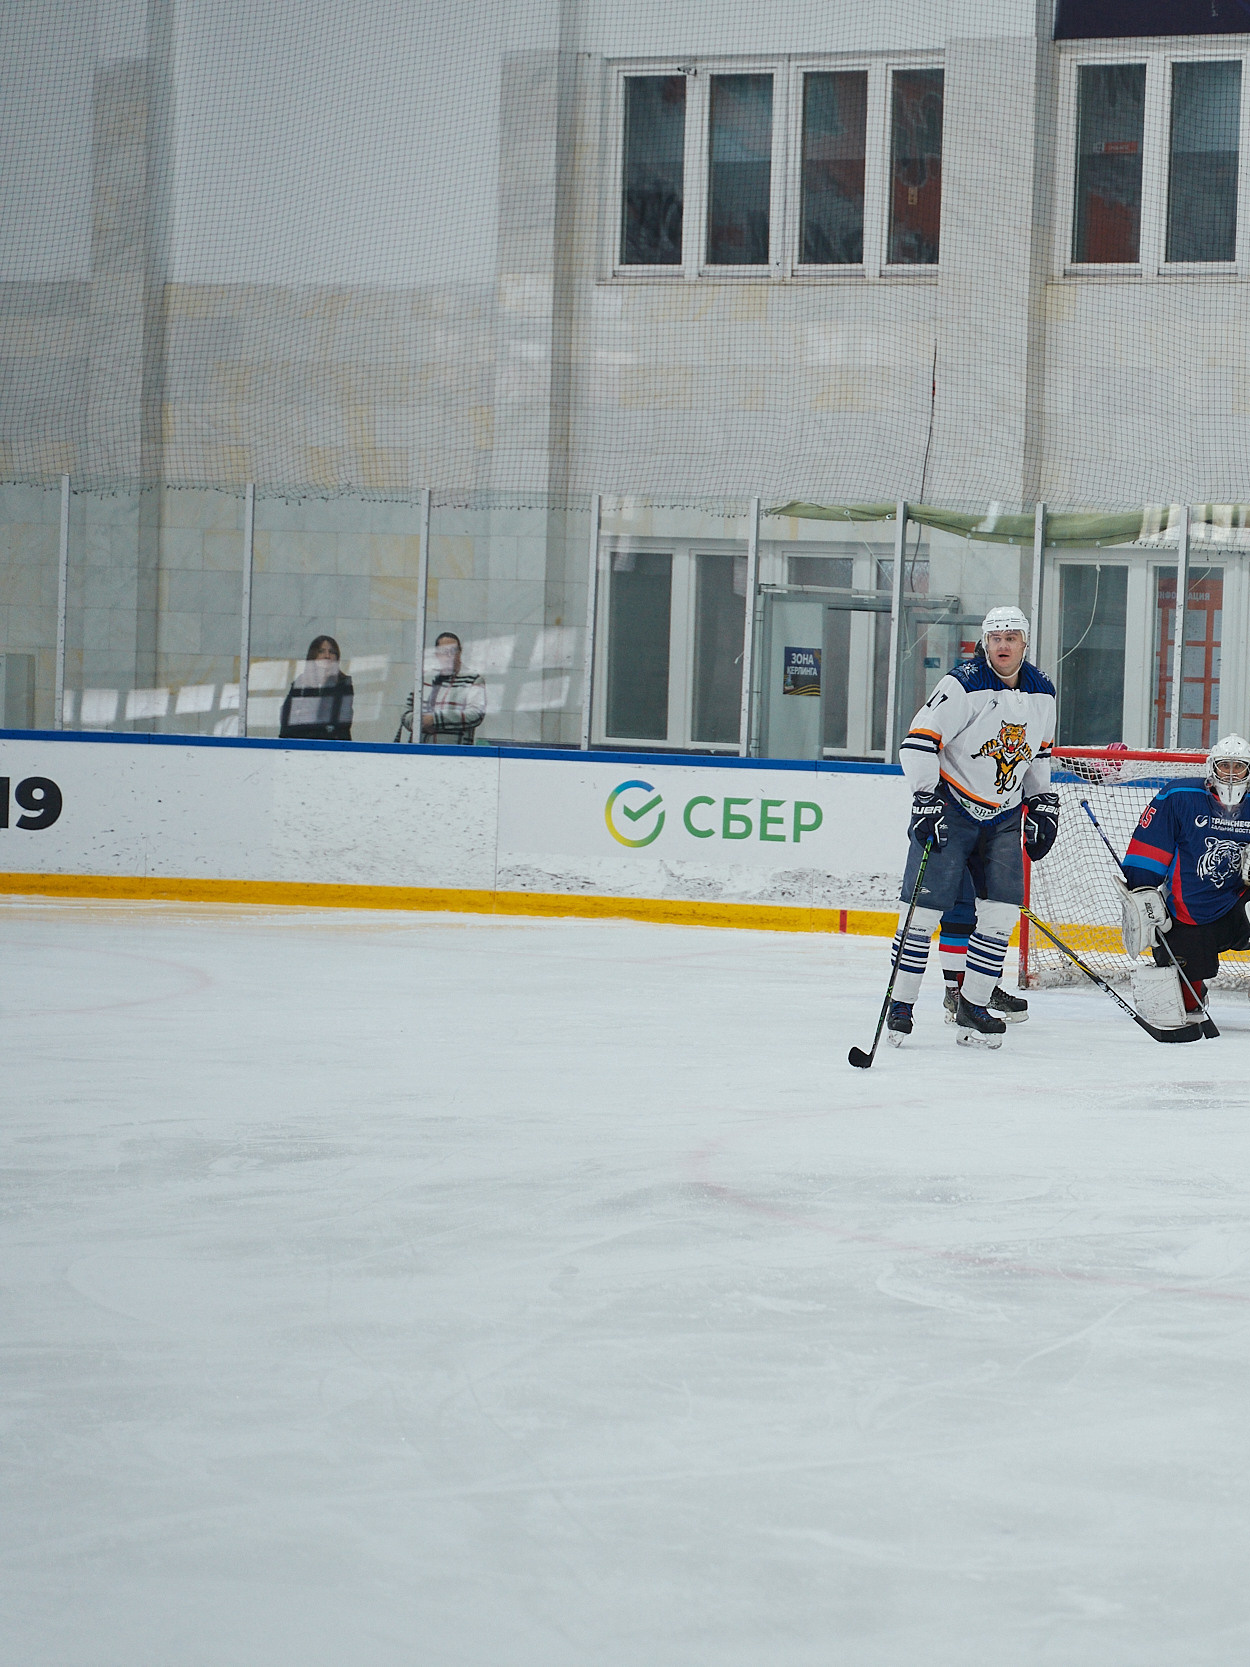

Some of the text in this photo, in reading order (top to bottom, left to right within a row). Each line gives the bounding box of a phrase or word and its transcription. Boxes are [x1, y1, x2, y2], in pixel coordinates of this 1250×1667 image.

[791, 652, 814, 665] ЗОНА
[786, 665, 818, 676] КЕРЛИНГА
[683, 795, 824, 843] СБЕР
